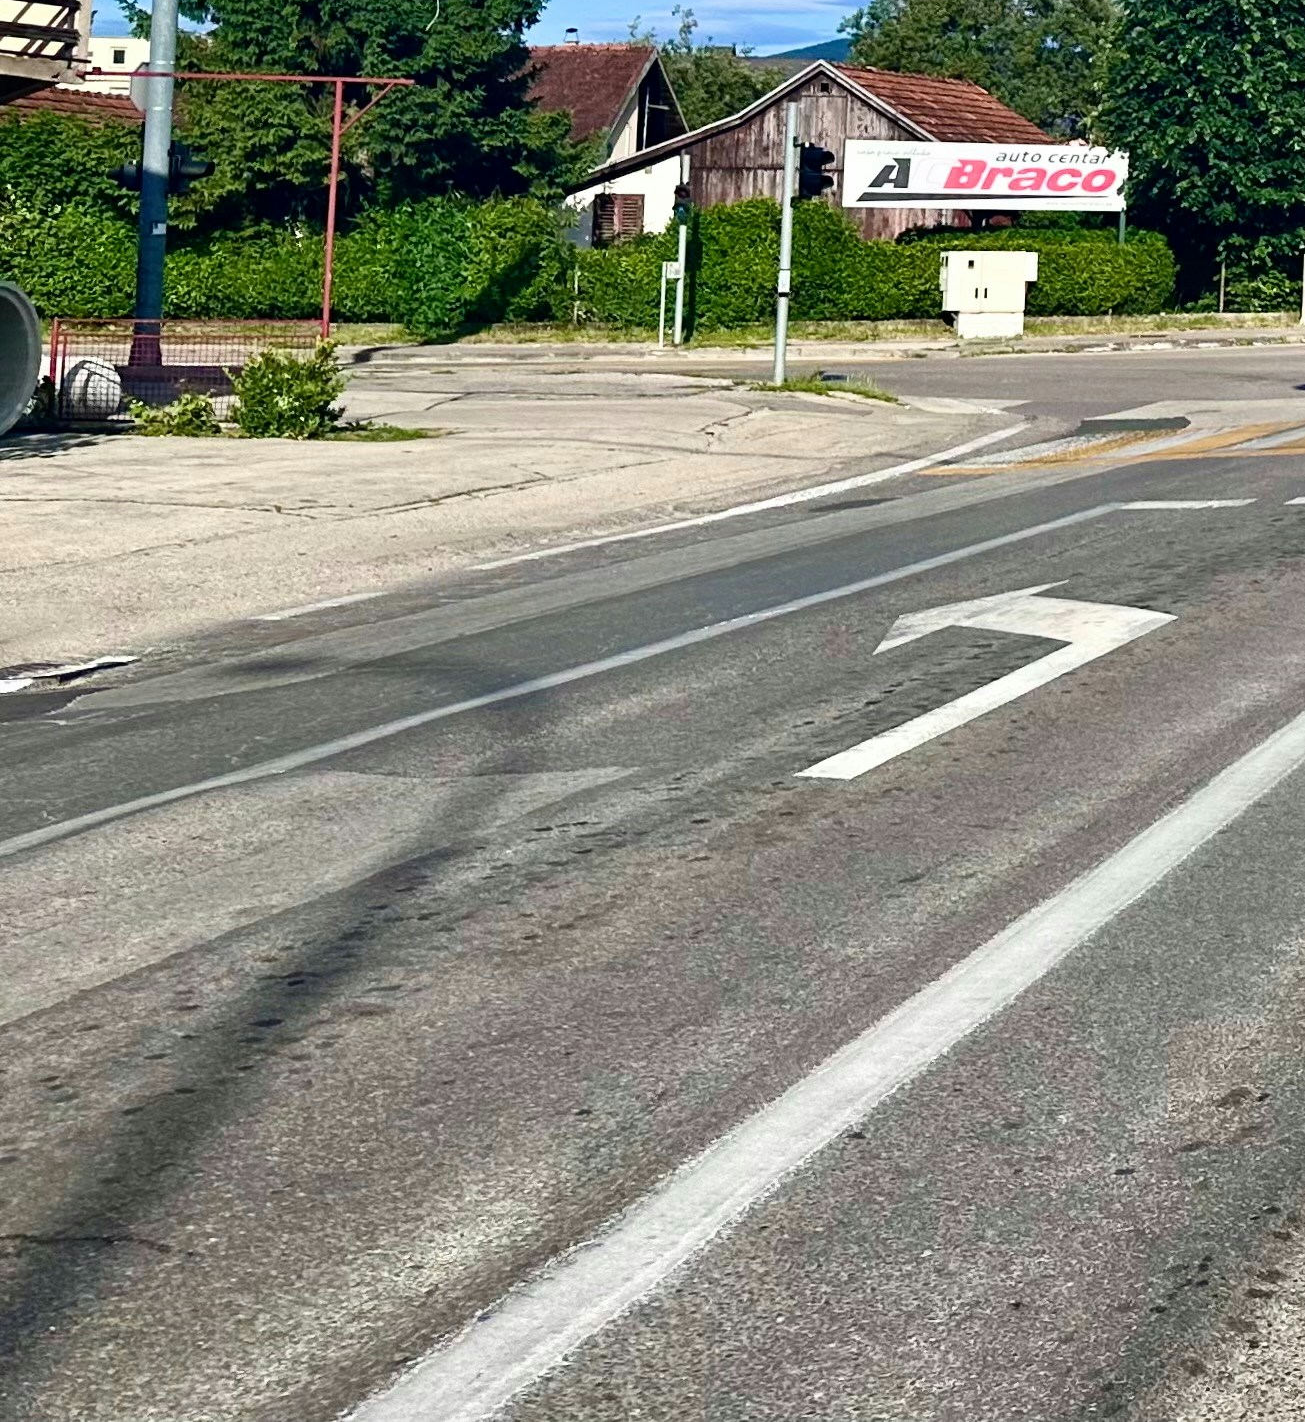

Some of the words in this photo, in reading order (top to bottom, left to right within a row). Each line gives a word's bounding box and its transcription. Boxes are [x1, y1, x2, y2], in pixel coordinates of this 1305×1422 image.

[995, 151, 1042, 163] auto
[1047, 153, 1108, 165] centar
[943, 158, 1117, 193] Braco
